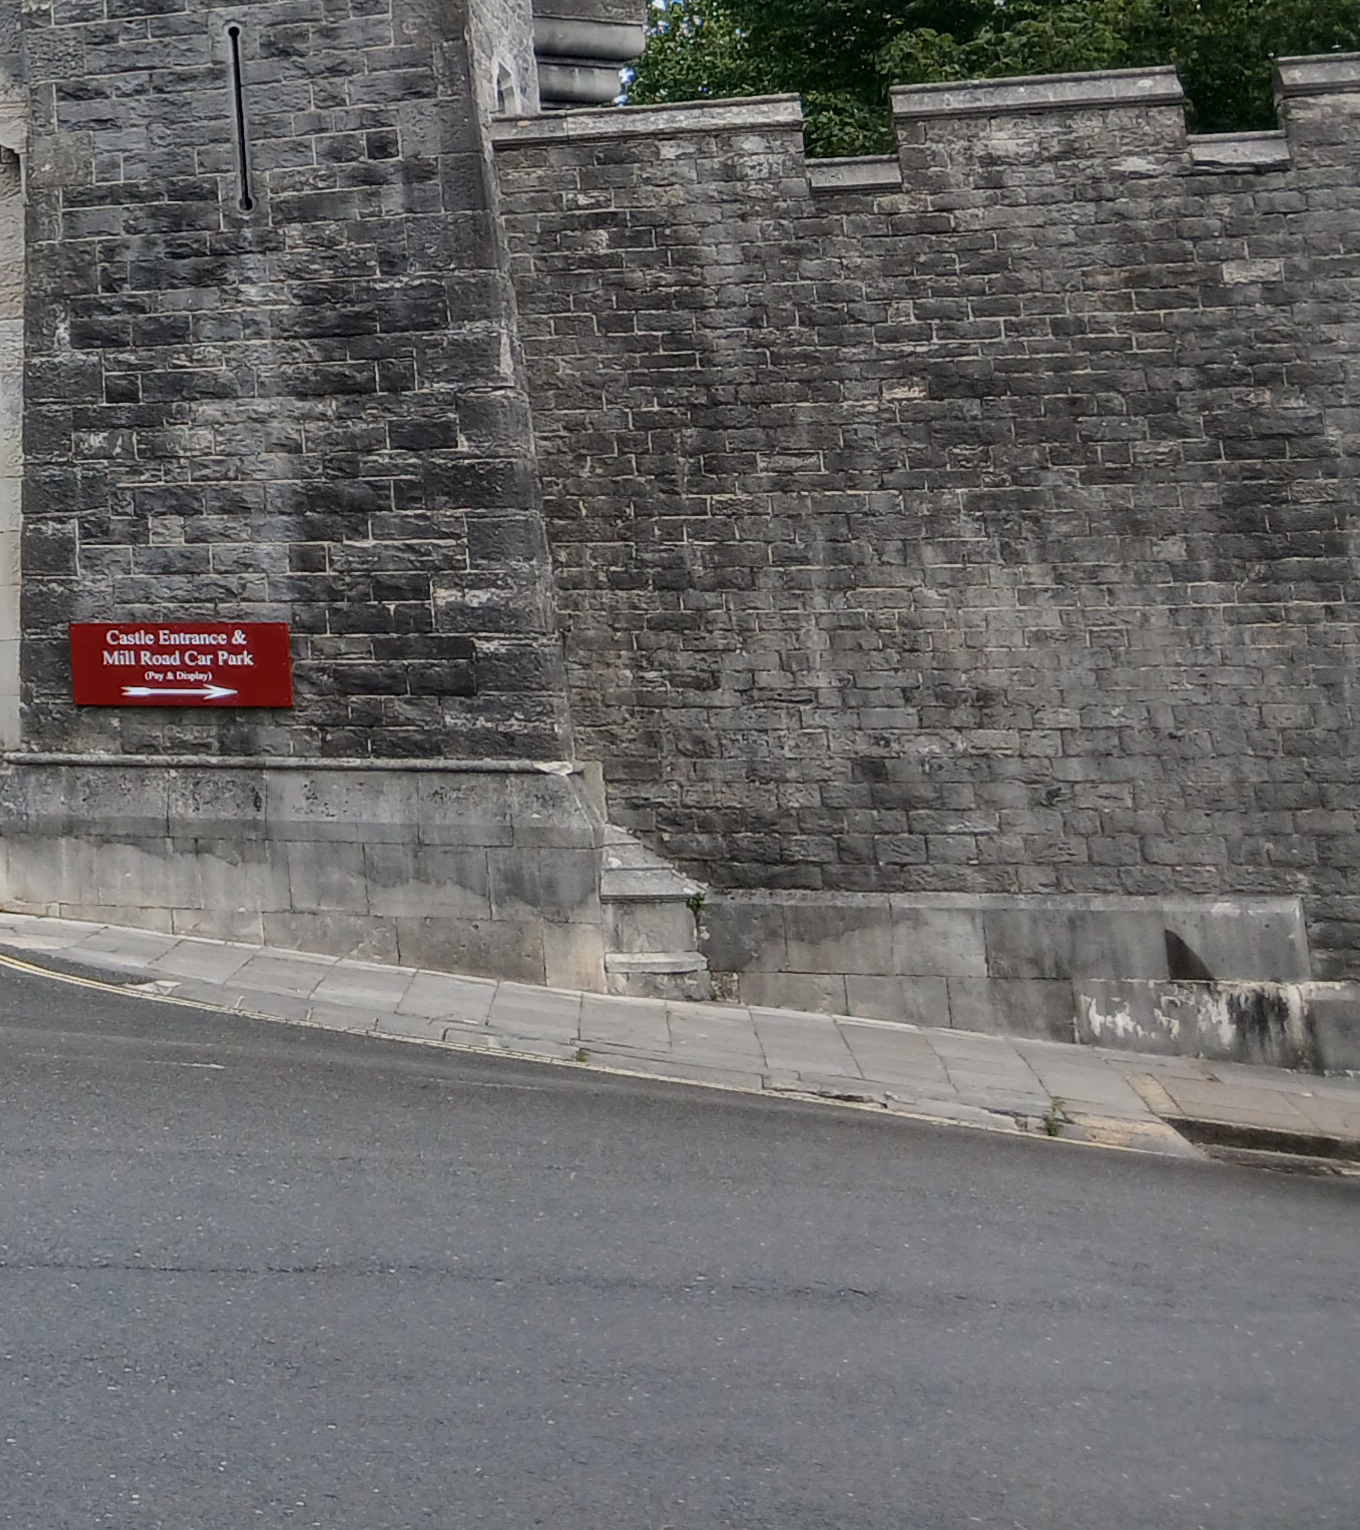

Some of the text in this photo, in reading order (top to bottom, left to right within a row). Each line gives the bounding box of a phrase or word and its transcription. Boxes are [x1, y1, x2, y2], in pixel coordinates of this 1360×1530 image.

[106, 629, 248, 645] Castle Entrance &
[102, 650, 255, 666] Mill Road Car Park
